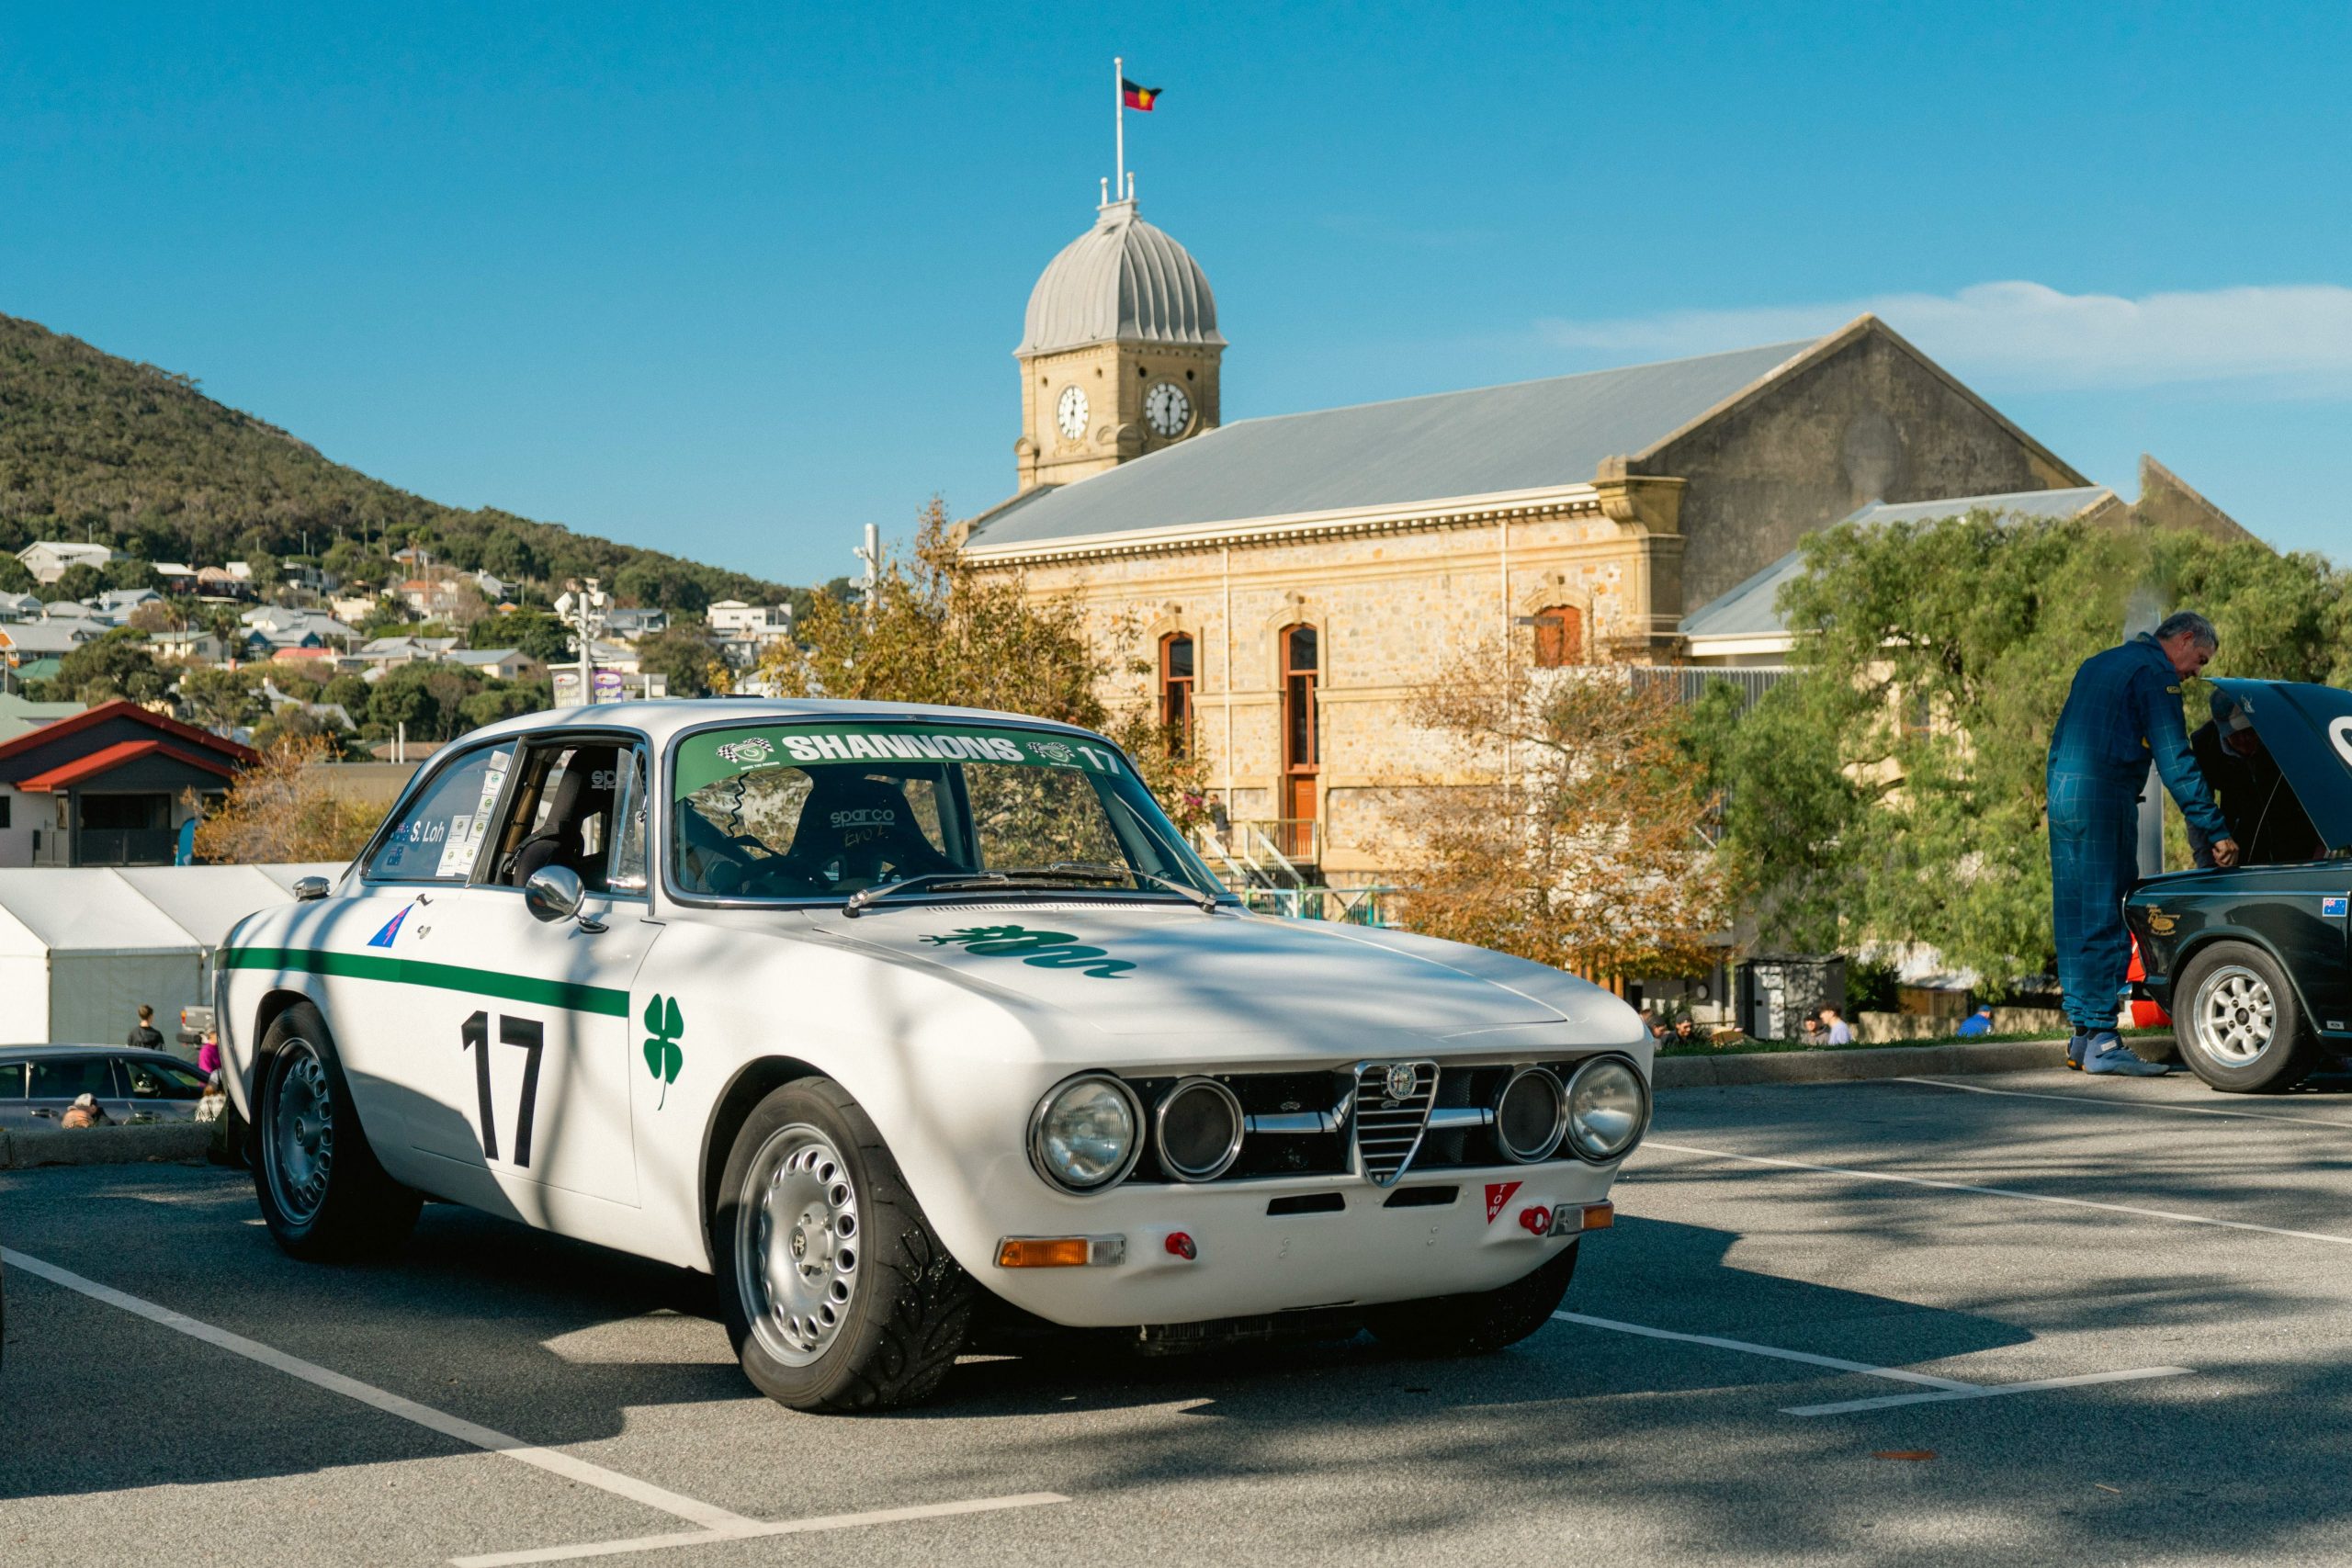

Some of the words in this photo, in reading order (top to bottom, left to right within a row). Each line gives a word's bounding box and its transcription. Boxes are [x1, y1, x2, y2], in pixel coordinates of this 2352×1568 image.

[781, 734, 1025, 761] SHANNONS
[1077, 746, 1120, 775] 17
[410, 820, 422, 842] S.
[423, 821, 446, 842] Loh
[830, 808, 896, 829] sparco
[460, 1010, 545, 1169] 17
[1488, 1183, 1508, 1216] TOW
